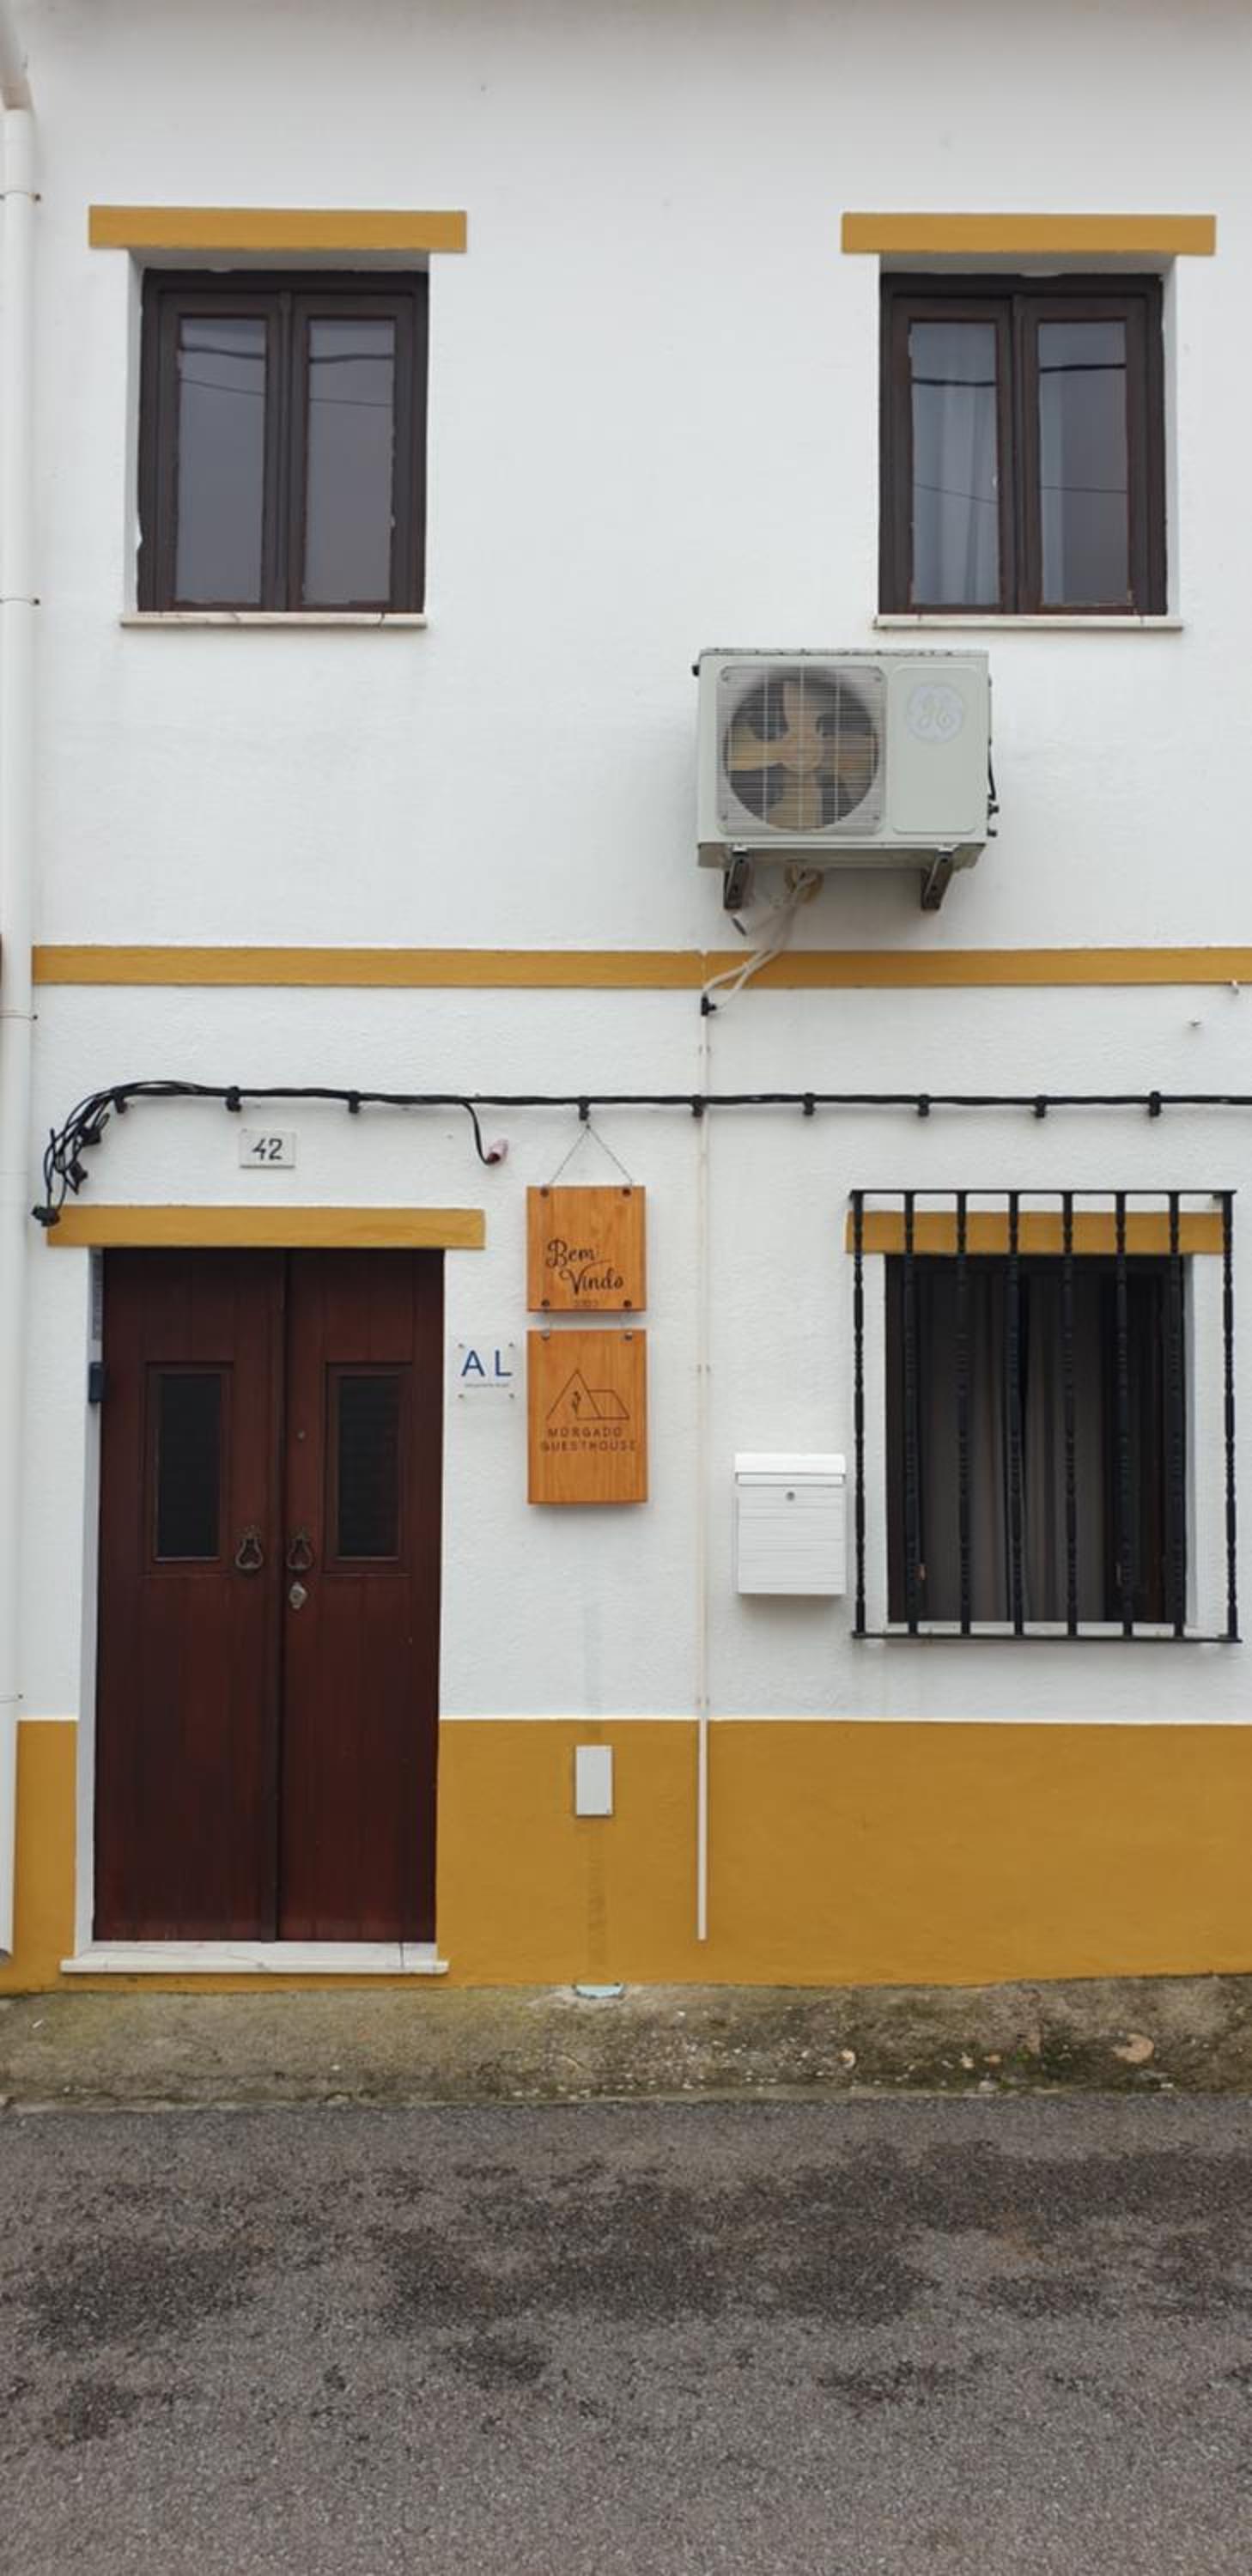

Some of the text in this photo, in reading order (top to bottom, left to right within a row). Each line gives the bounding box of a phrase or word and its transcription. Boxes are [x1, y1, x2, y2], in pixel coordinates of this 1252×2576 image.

[252, 1138, 283, 1160] 42
[545, 1239, 595, 1268] Bem
[559, 1260, 624, 1295] Vindo
[548, 1426, 623, 1438] MORGADO
[540, 1440, 635, 1452] GUESTHOUSE
